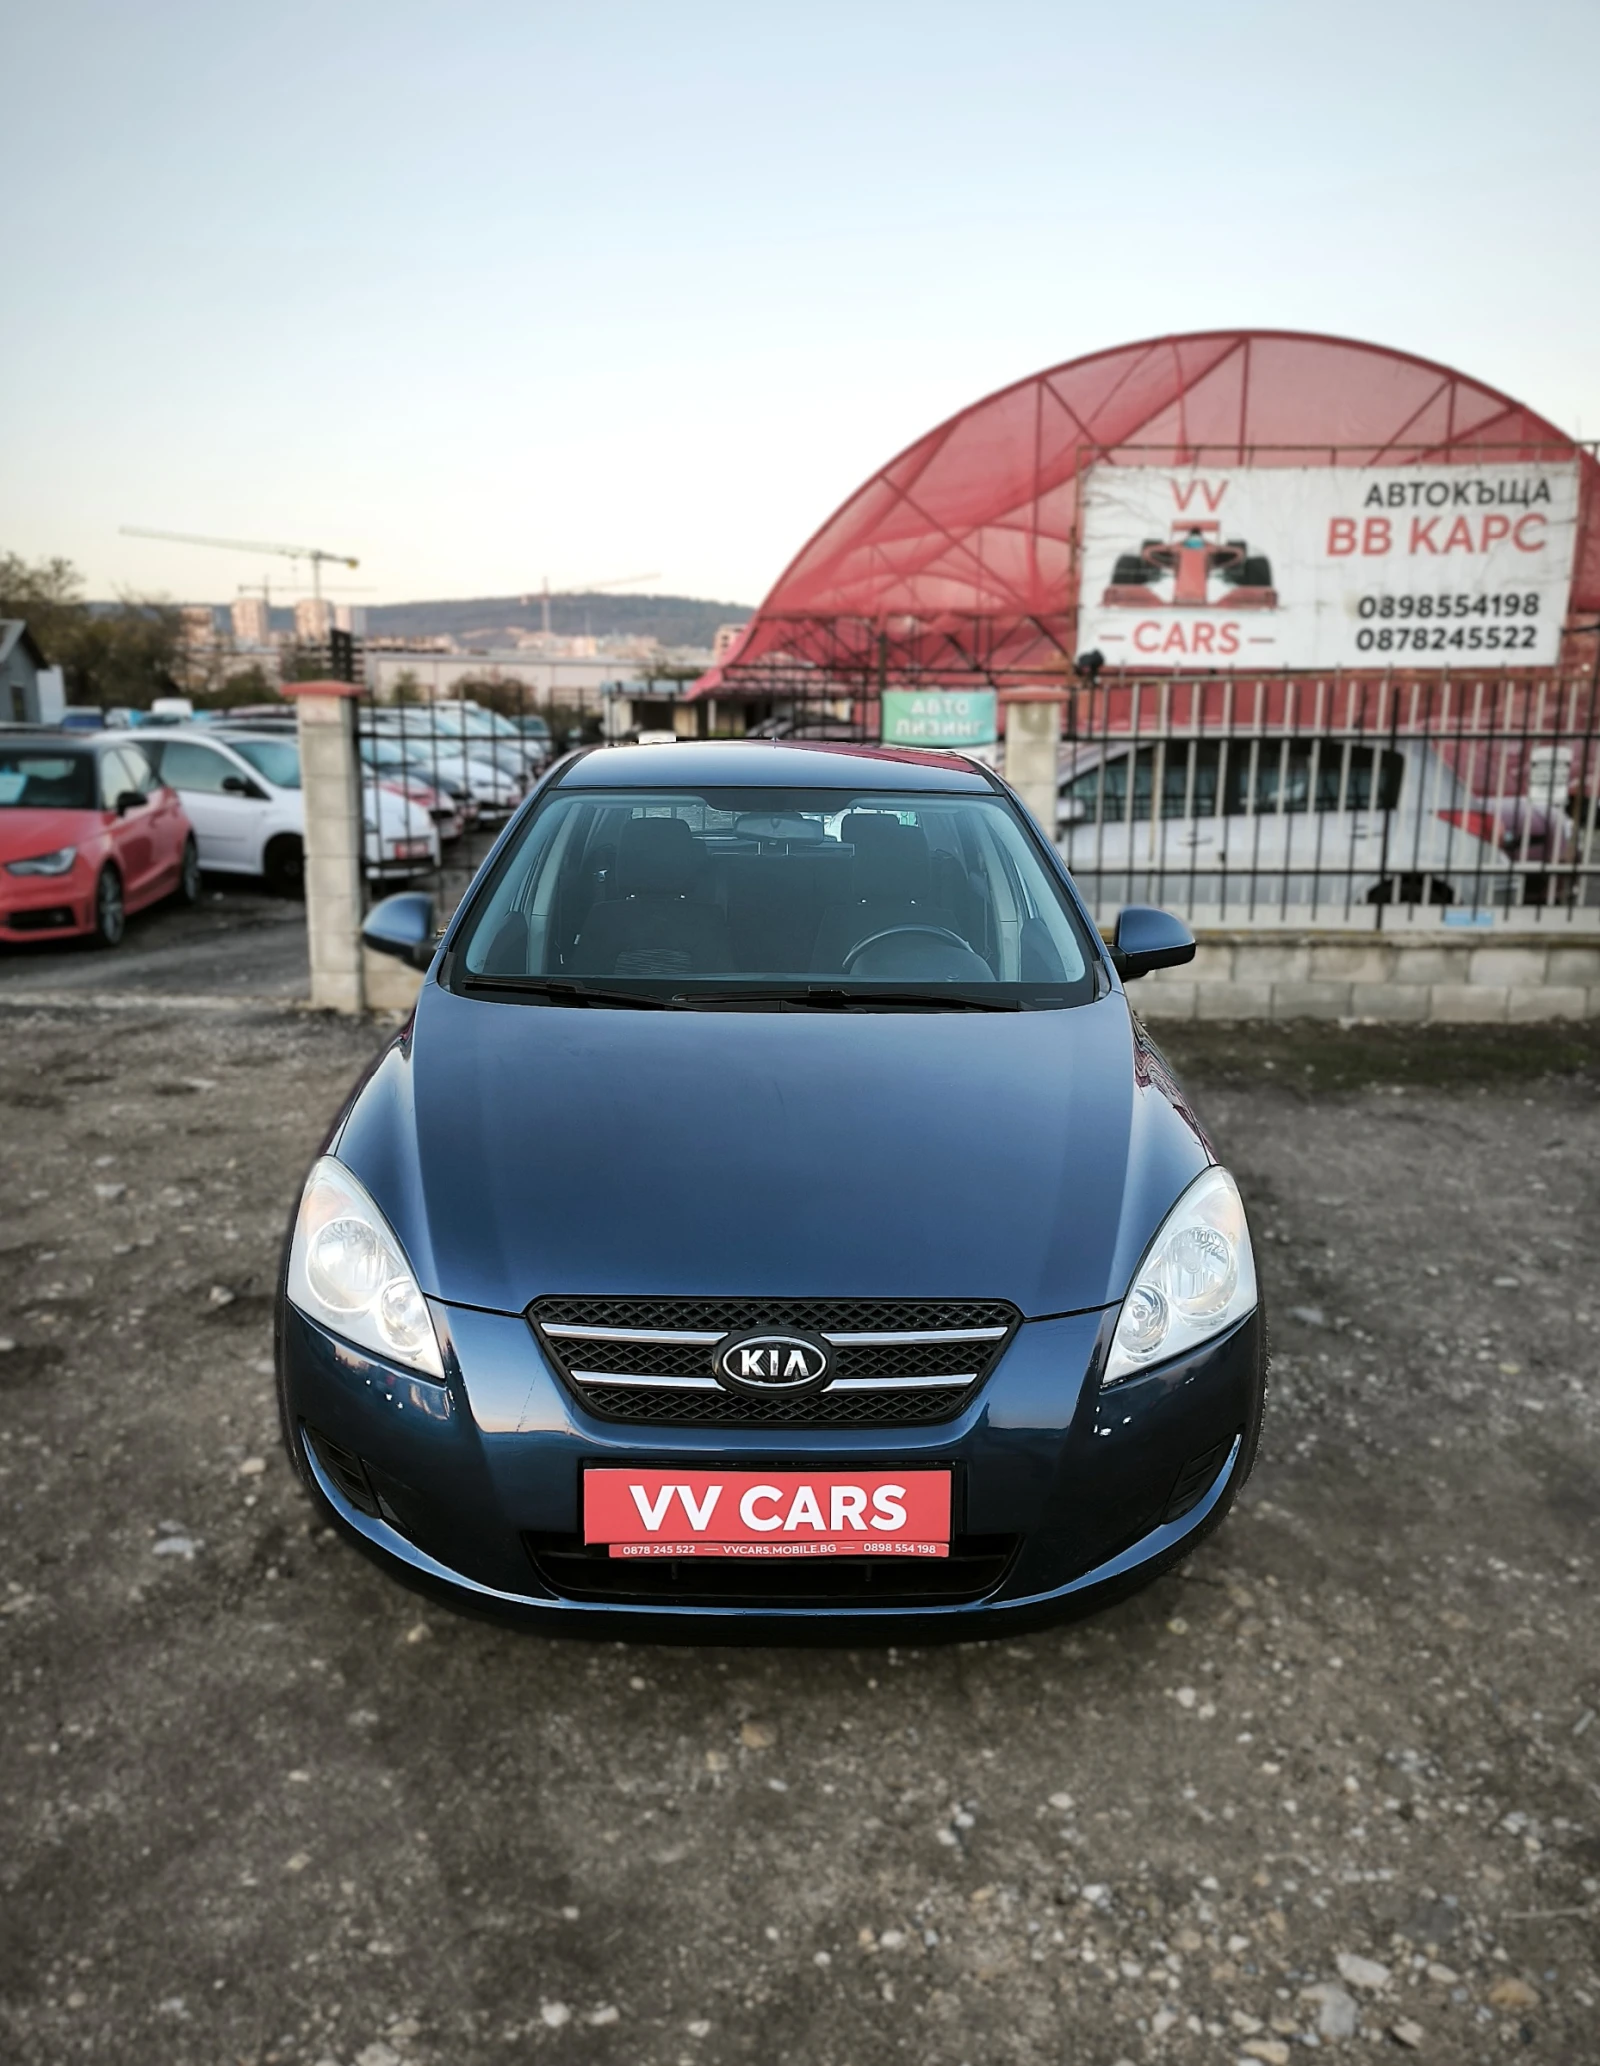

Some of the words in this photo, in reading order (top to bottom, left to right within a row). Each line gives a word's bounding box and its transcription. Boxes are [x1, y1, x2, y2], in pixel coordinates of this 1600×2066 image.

[1170, 479, 1229, 512] VV
[1364, 479, 1552, 508] АВТОКЪЩА
[1327, 516, 1393, 557] ВВ
[1408, 512, 1548, 555] КАРС
[1357, 593, 1540, 619] 0898554198
[1132, 621, 1241, 654] CARS
[1356, 626, 1537, 651] 0878245522
[911, 698, 969, 716] АВТО
[895, 718, 985, 737] ЛИЗИНГ
[740, 1349, 810, 1377] KIA
[628, 1485, 723, 1532] VV
[739, 1484, 908, 1532] CARS
[622, 1546, 651, 1555] 0878
[653, 1545, 673, 1554] 245
[675, 1545, 696, 1554] 522
[722, 1544, 837, 1555] VVCARS.MOBILE.BG
[863, 1543, 892, 1552] 0898
[894, 1543, 915, 1553] 554
[917, 1544, 936, 1554] 198
